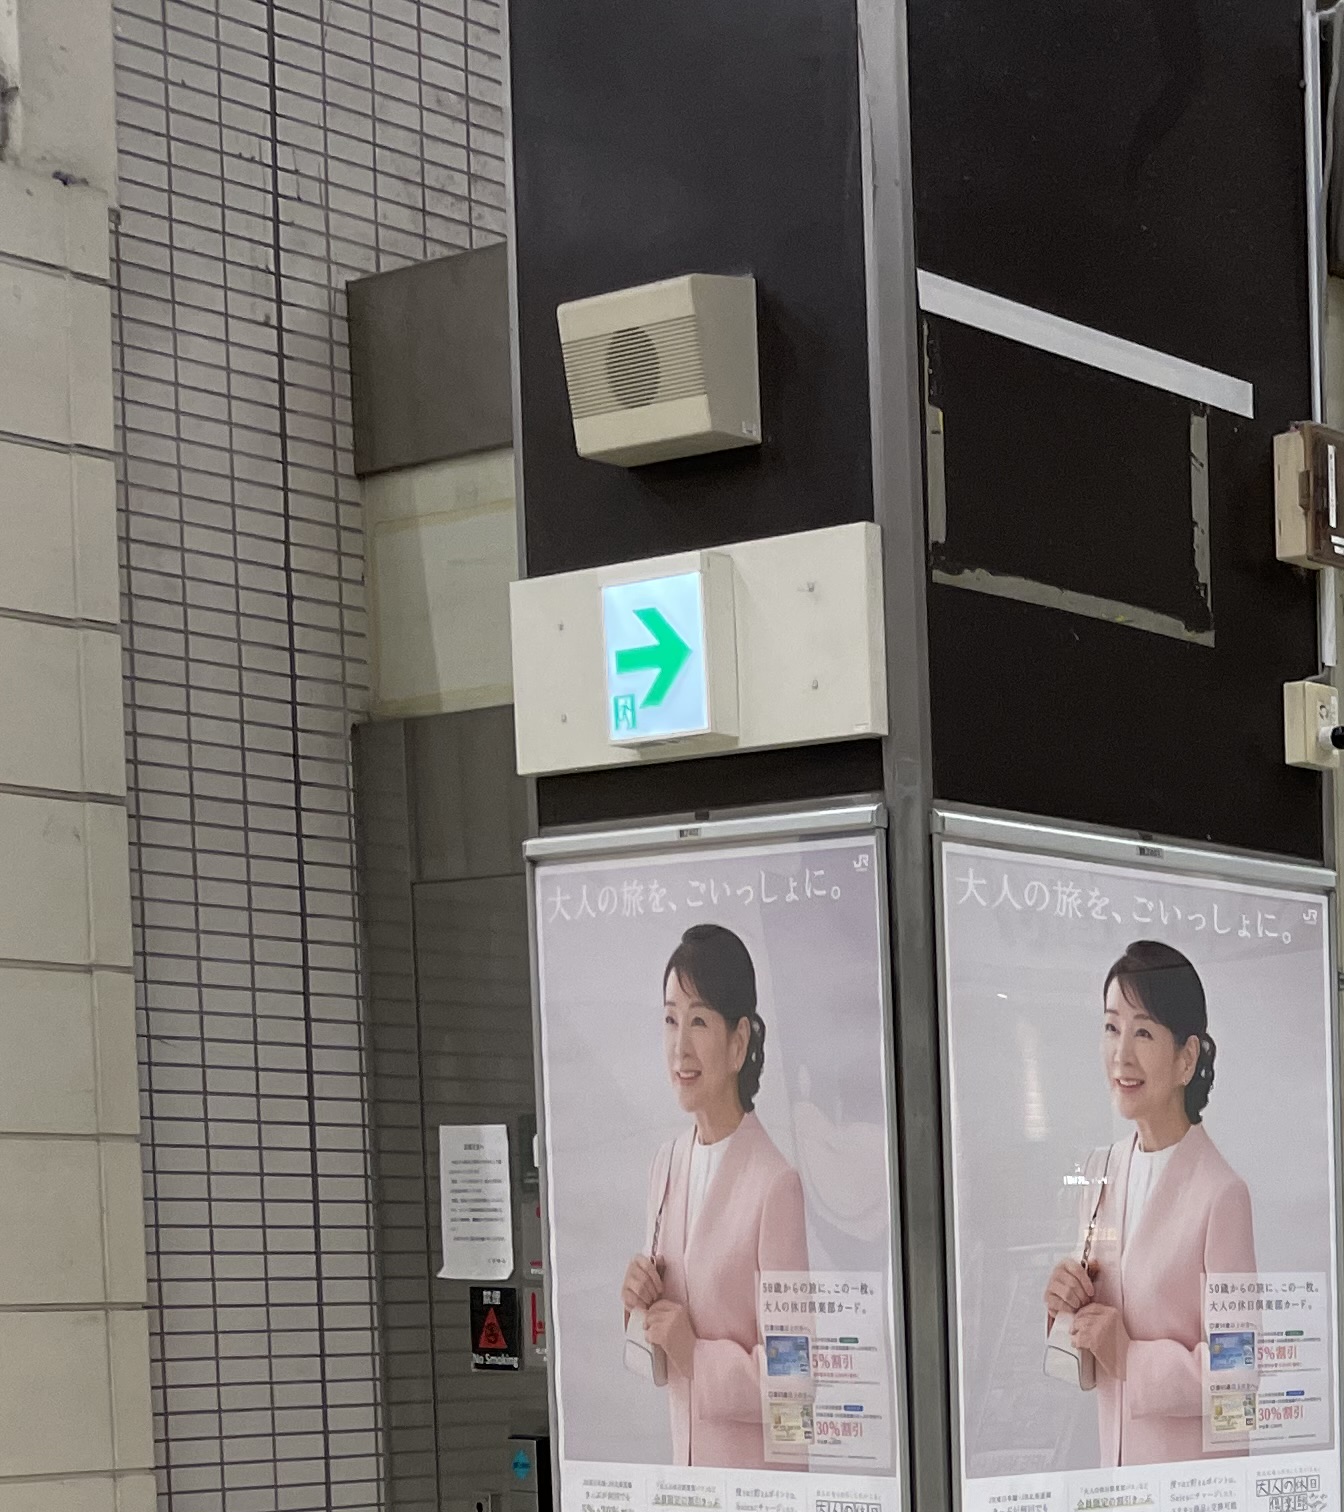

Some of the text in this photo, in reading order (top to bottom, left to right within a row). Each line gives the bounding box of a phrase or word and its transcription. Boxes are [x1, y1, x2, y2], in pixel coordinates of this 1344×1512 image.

[548, 867, 841, 922] 大人の旅を、ごいっしょに。
[955, 867, 1292, 944] 大人の旅を、ごいっしょに。
[1256, 1474, 1321, 1497] 大人の休日
